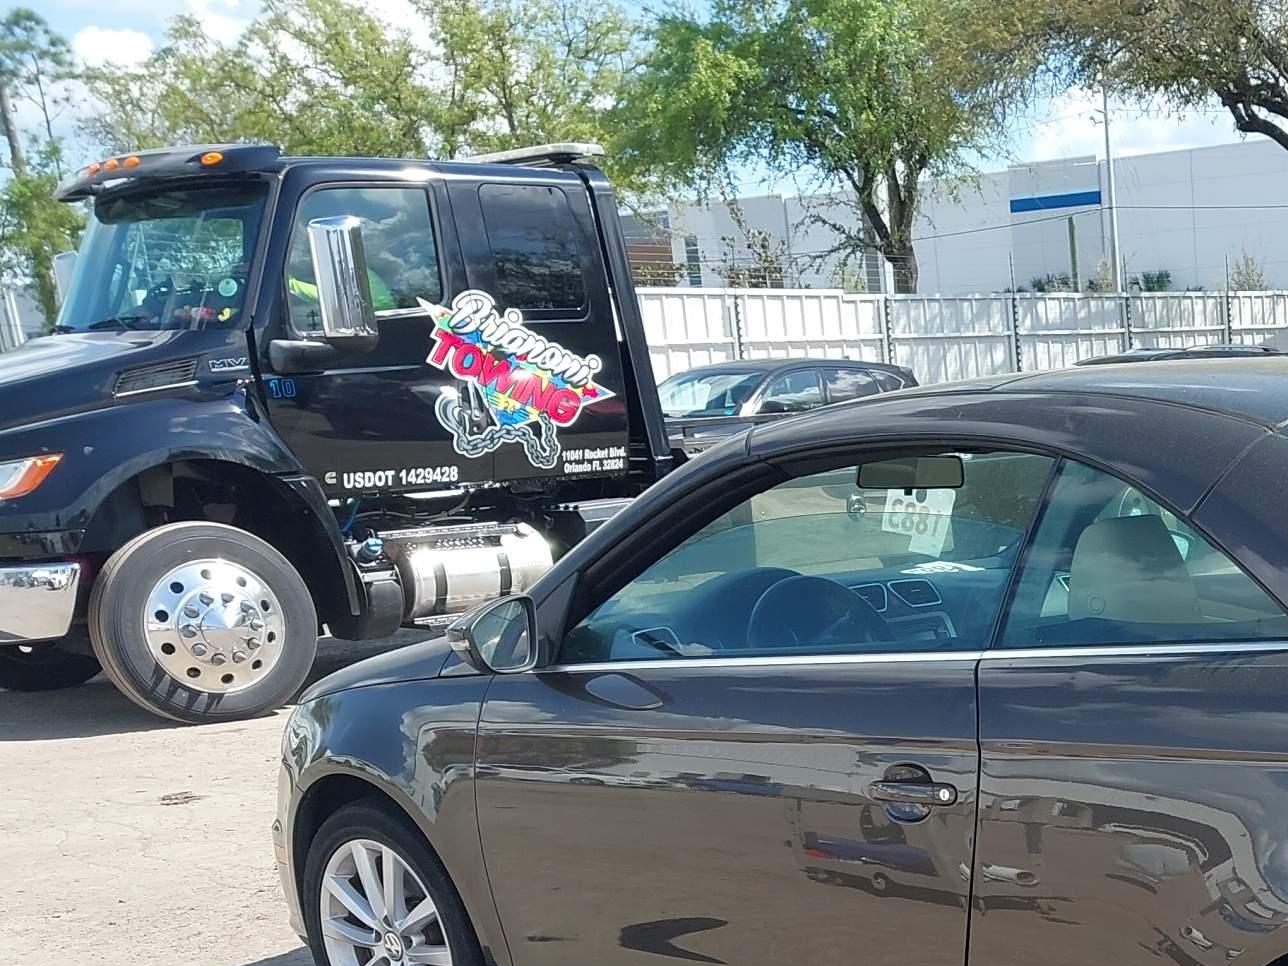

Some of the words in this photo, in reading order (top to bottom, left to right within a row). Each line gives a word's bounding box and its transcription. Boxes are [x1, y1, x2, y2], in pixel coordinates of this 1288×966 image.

[431, 328, 582, 424] TOWING
[269, 379, 296, 398] 10
[584, 448, 609, 459] Rocket
[564, 461, 591, 473] Orlando
[343, 469, 396, 489] USDOT
[399, 465, 459, 485] 1429428
